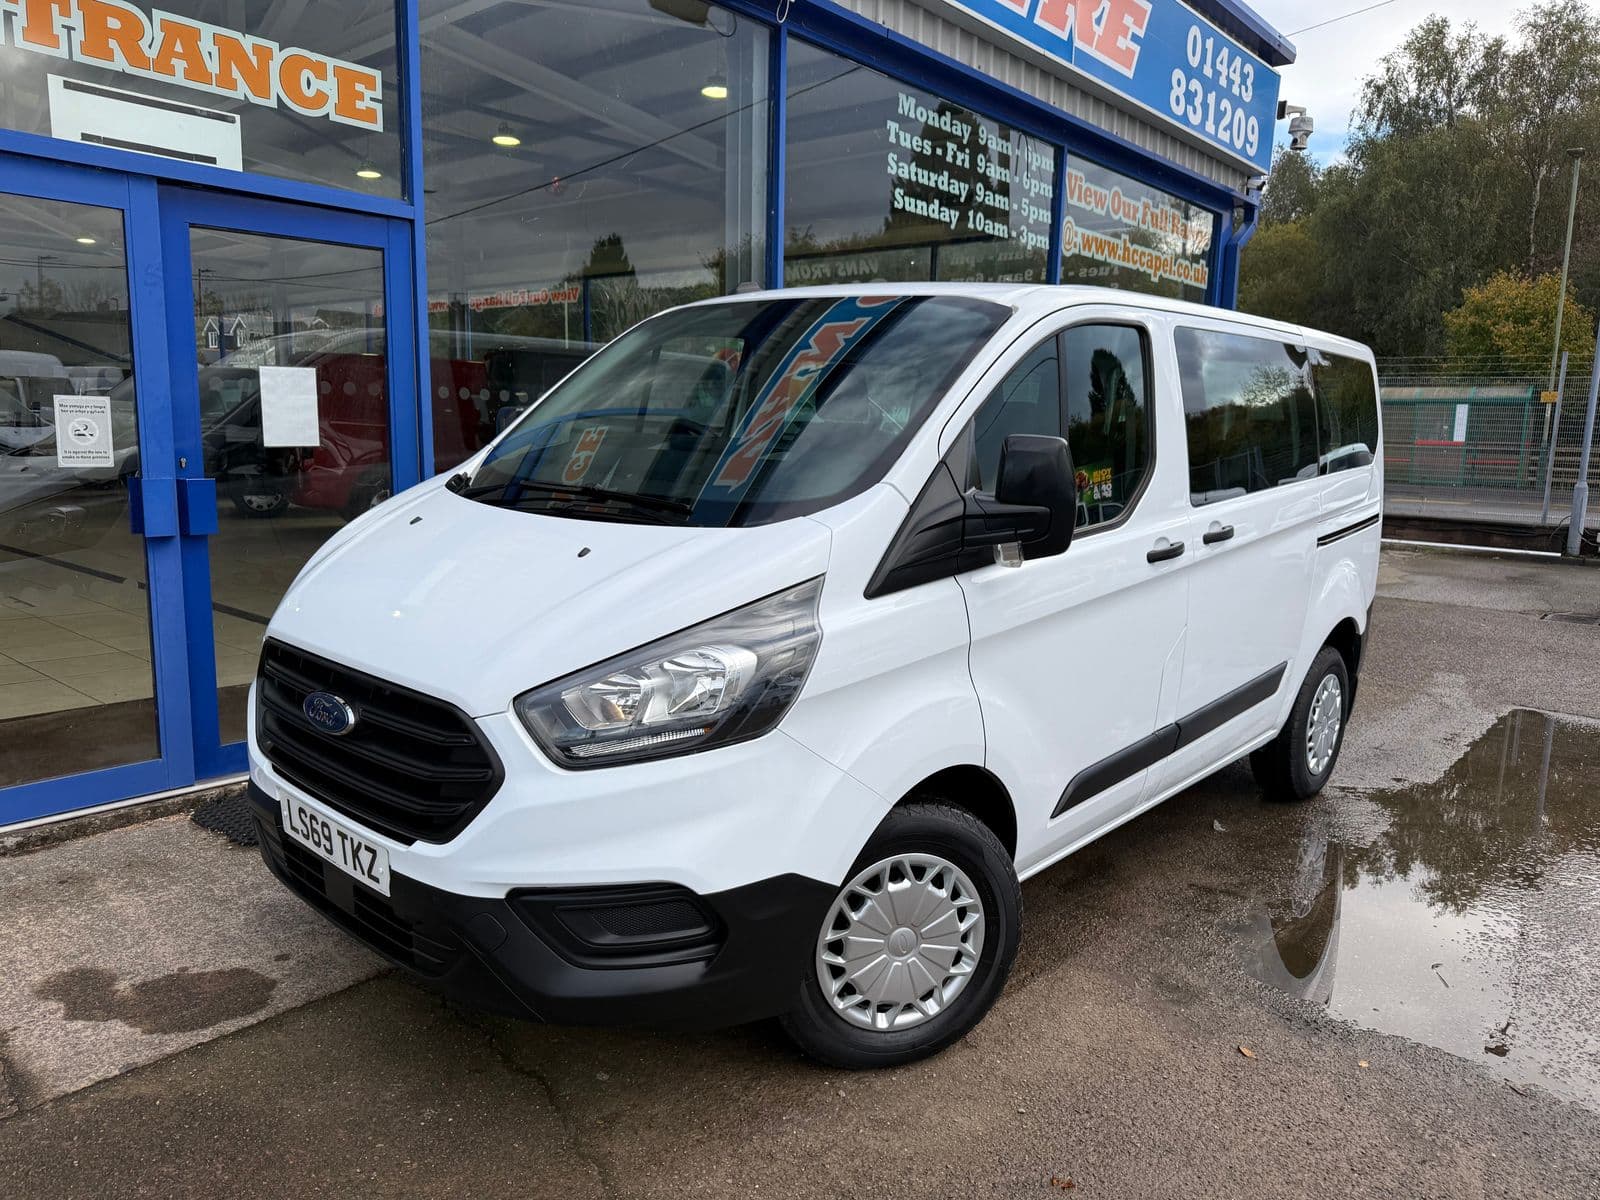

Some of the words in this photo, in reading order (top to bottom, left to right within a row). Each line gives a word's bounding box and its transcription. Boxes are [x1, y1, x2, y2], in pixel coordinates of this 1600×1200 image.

[1000, 0, 1151, 77] RE
[1186, 24, 1254, 103] 01443
[897, 92, 972, 145] Monday
[978, 126, 1012, 156] 9am
[1169, 68, 1259, 157] 831209
[886, 119, 932, 156] Tues
[945, 141, 970, 169] Fri
[977, 156, 1011, 183] 9am
[1023, 170, 1053, 198] 6pm
[886, 152, 970, 203] Saturday
[975, 183, 1010, 211] 9am
[1021, 198, 1052, 225] 5pm
[893, 187, 960, 230] Sunday
[967, 209, 1009, 239] 10am
[1019, 225, 1050, 250] 3pm
[1067, 169, 1109, 214] View
[1110, 188, 1140, 223] Our
[1141, 199, 1169, 232] Full
[1080, 231, 1208, 287] www.hccapel.co.uk
[286, 798, 334, 856] LS69
[336, 829, 380, 885] TKZ
